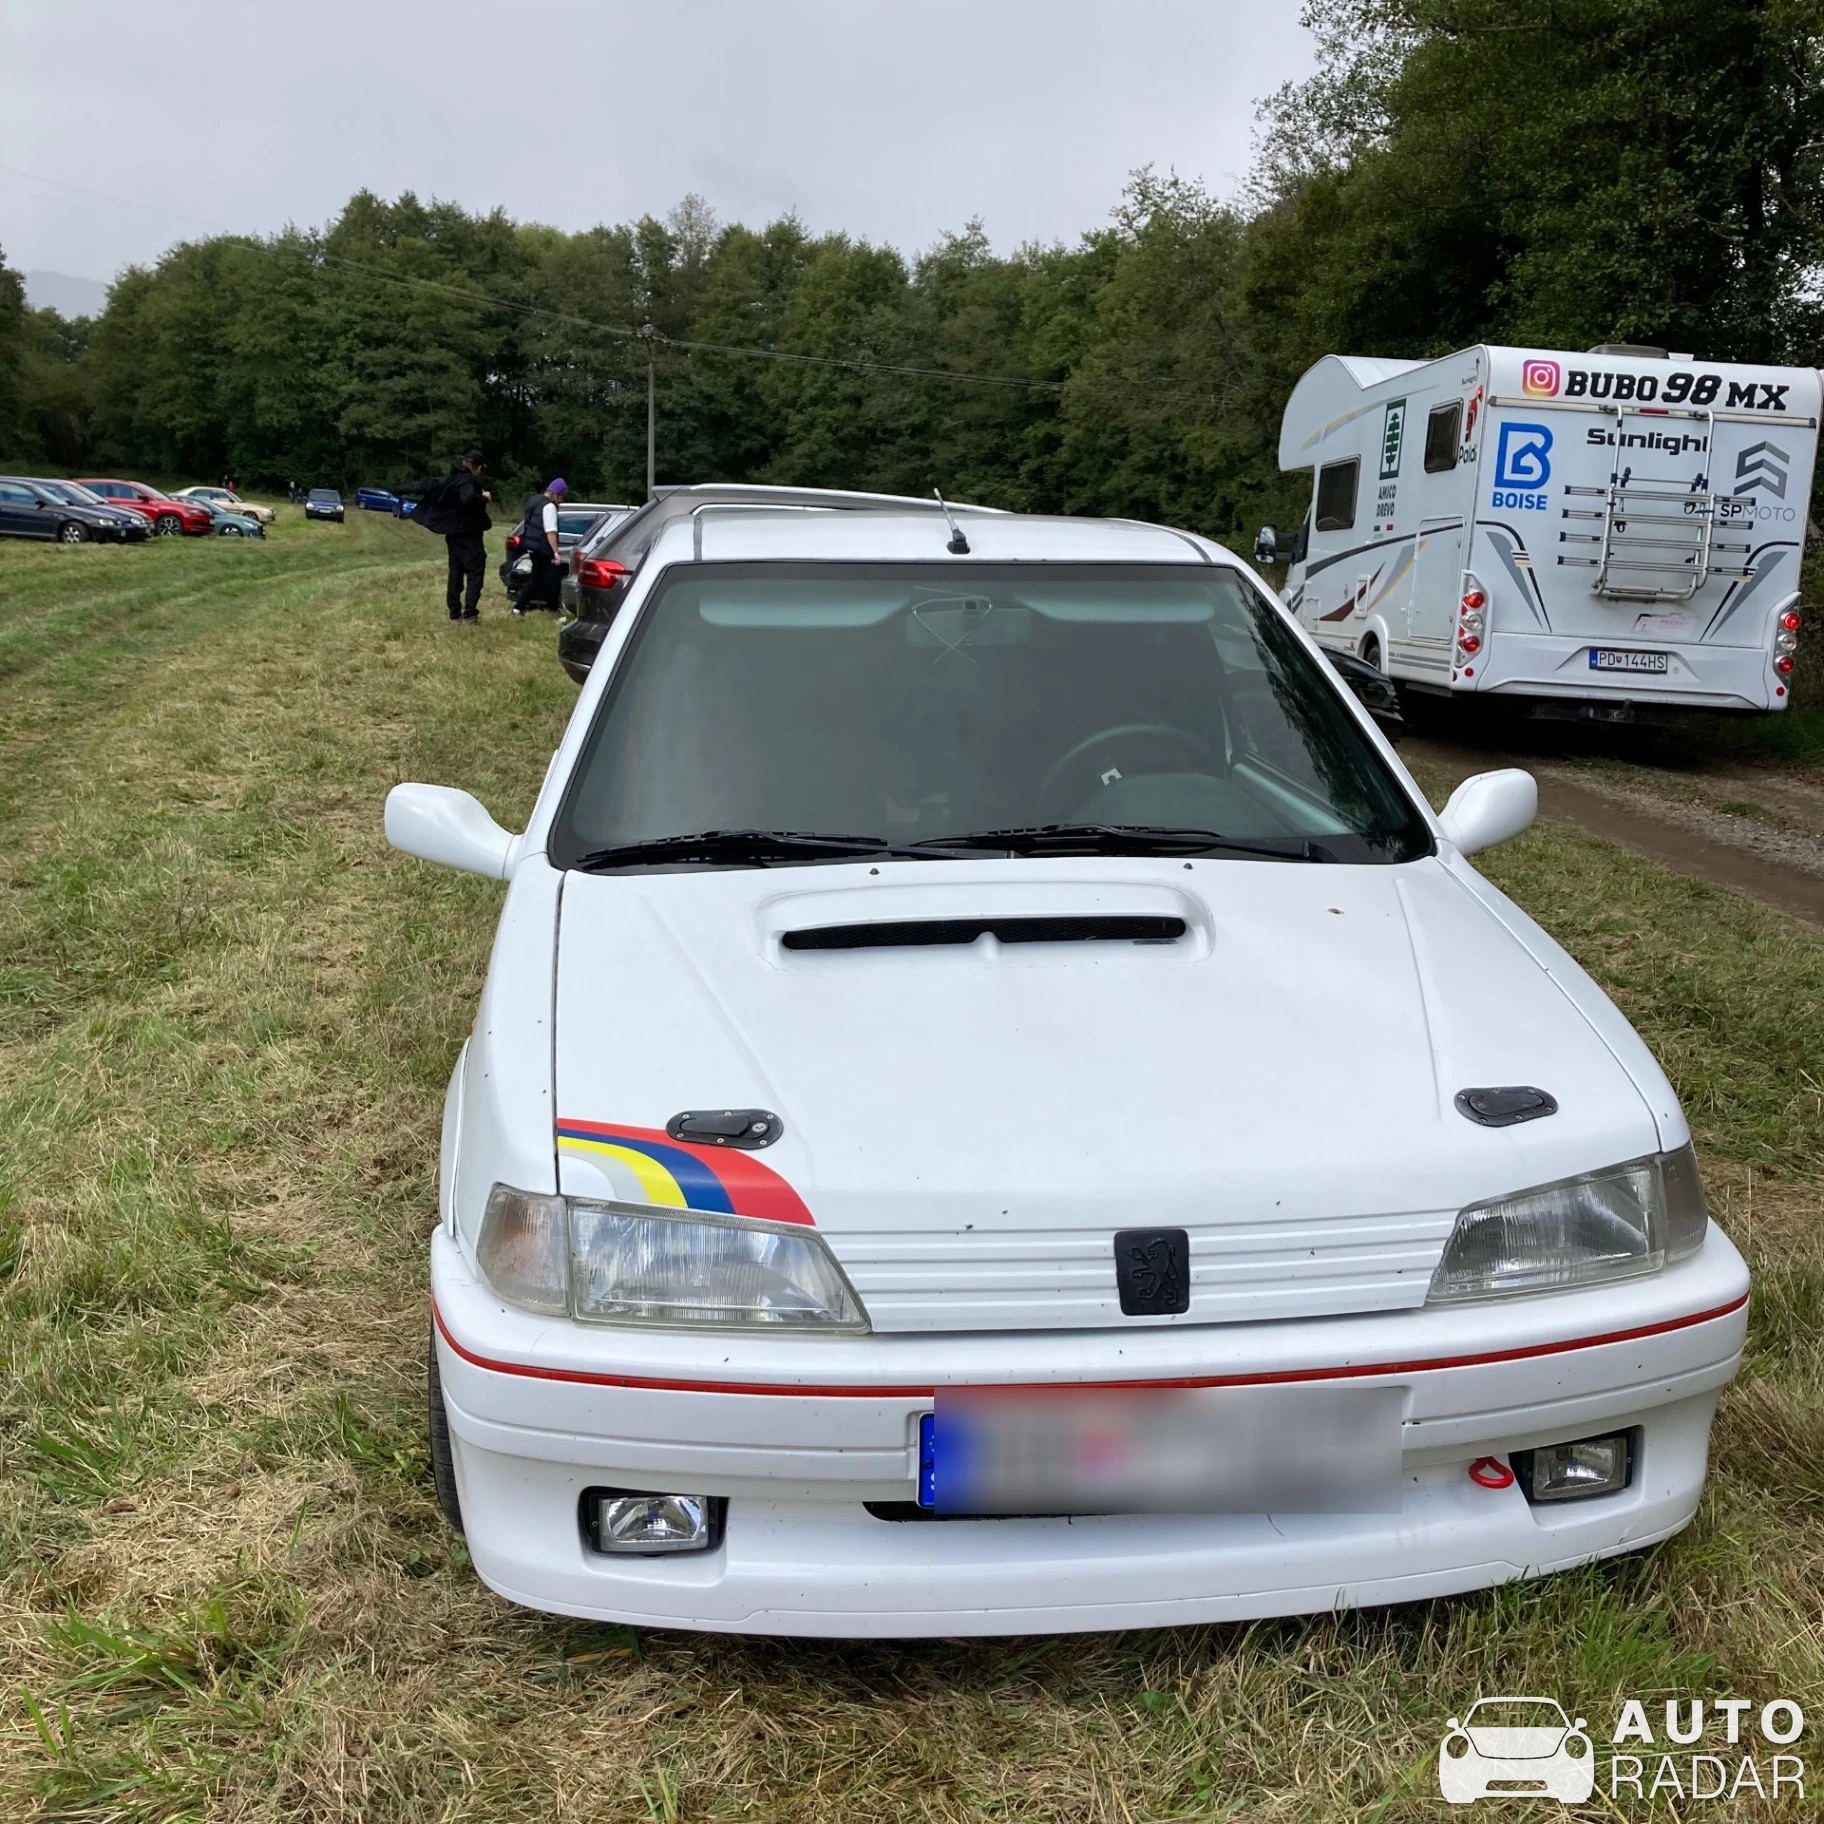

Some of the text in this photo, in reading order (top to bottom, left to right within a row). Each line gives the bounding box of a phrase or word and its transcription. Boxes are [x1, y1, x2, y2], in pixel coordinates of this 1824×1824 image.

[1565, 370, 1790, 411] BUBO 98 MX
[1378, 484, 1397, 500] AMICO
[1492, 491, 1549, 511] BOISE
[1376, 501, 1395, 518] DREVO
